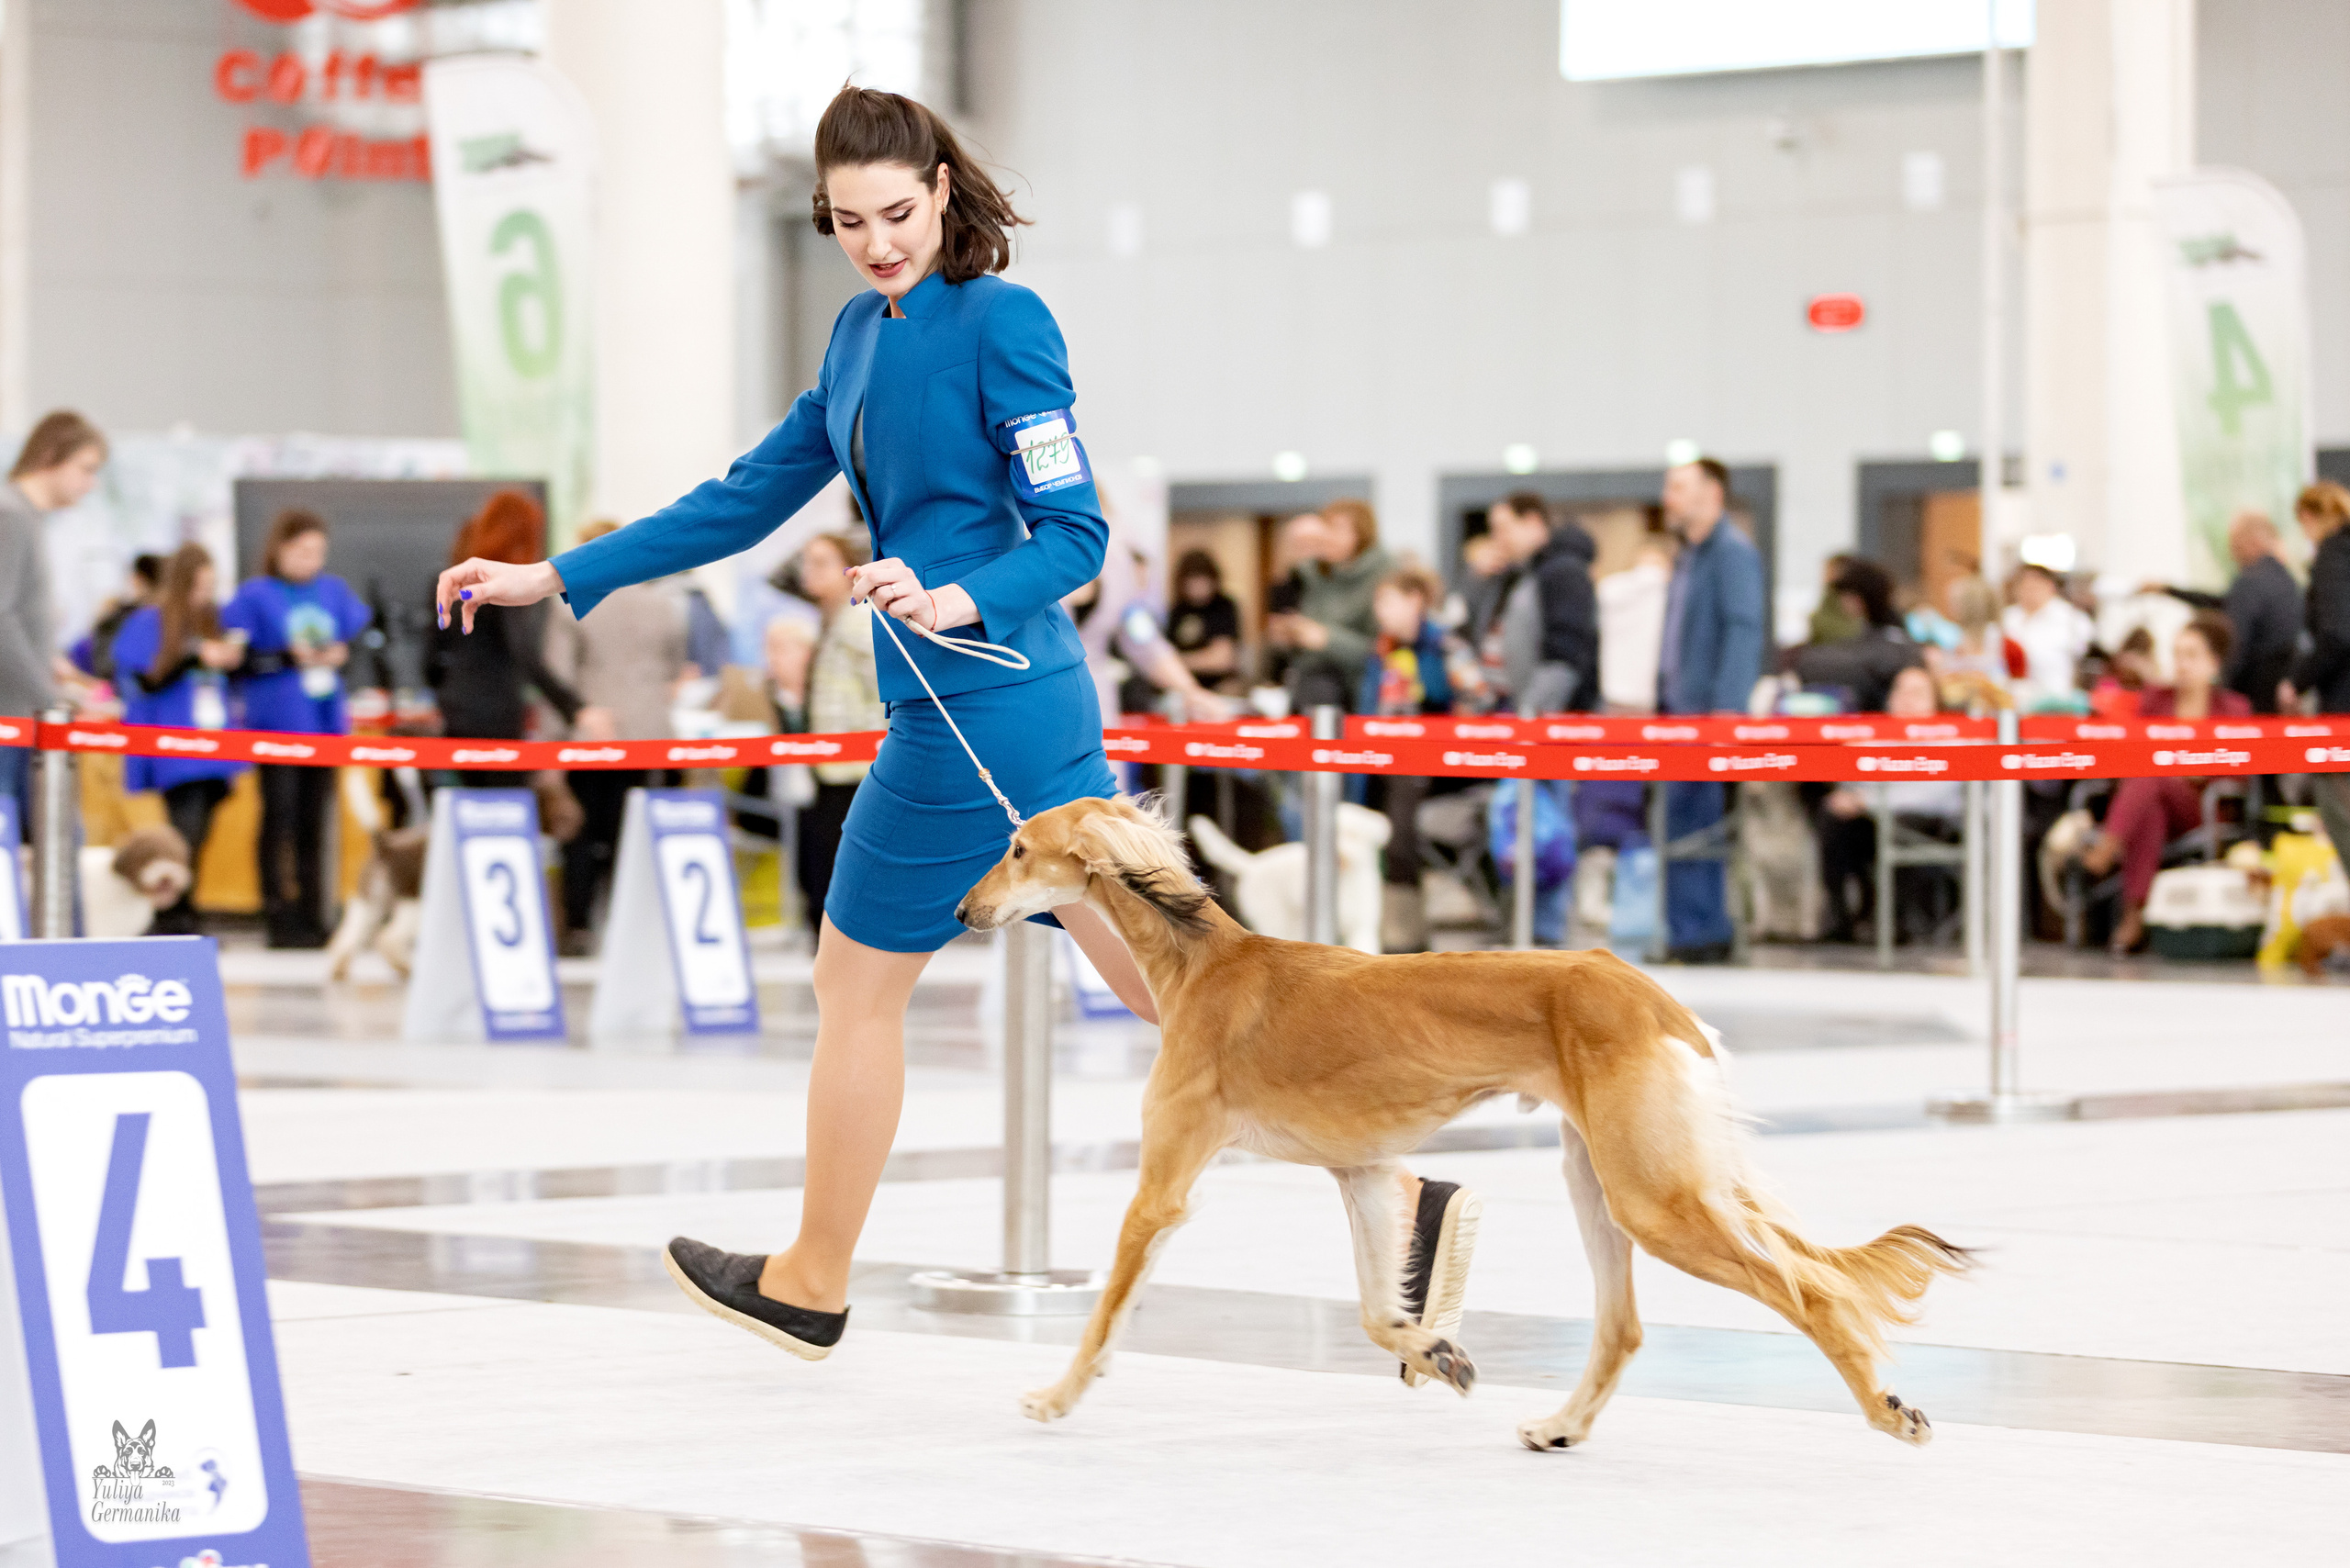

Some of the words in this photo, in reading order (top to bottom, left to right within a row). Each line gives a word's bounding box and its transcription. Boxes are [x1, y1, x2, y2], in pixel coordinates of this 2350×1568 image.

[1025, 431, 1070, 475] 1279
[484, 860, 526, 948] 3
[681, 859, 722, 946] 2
[85, 1111, 208, 1369] 4
